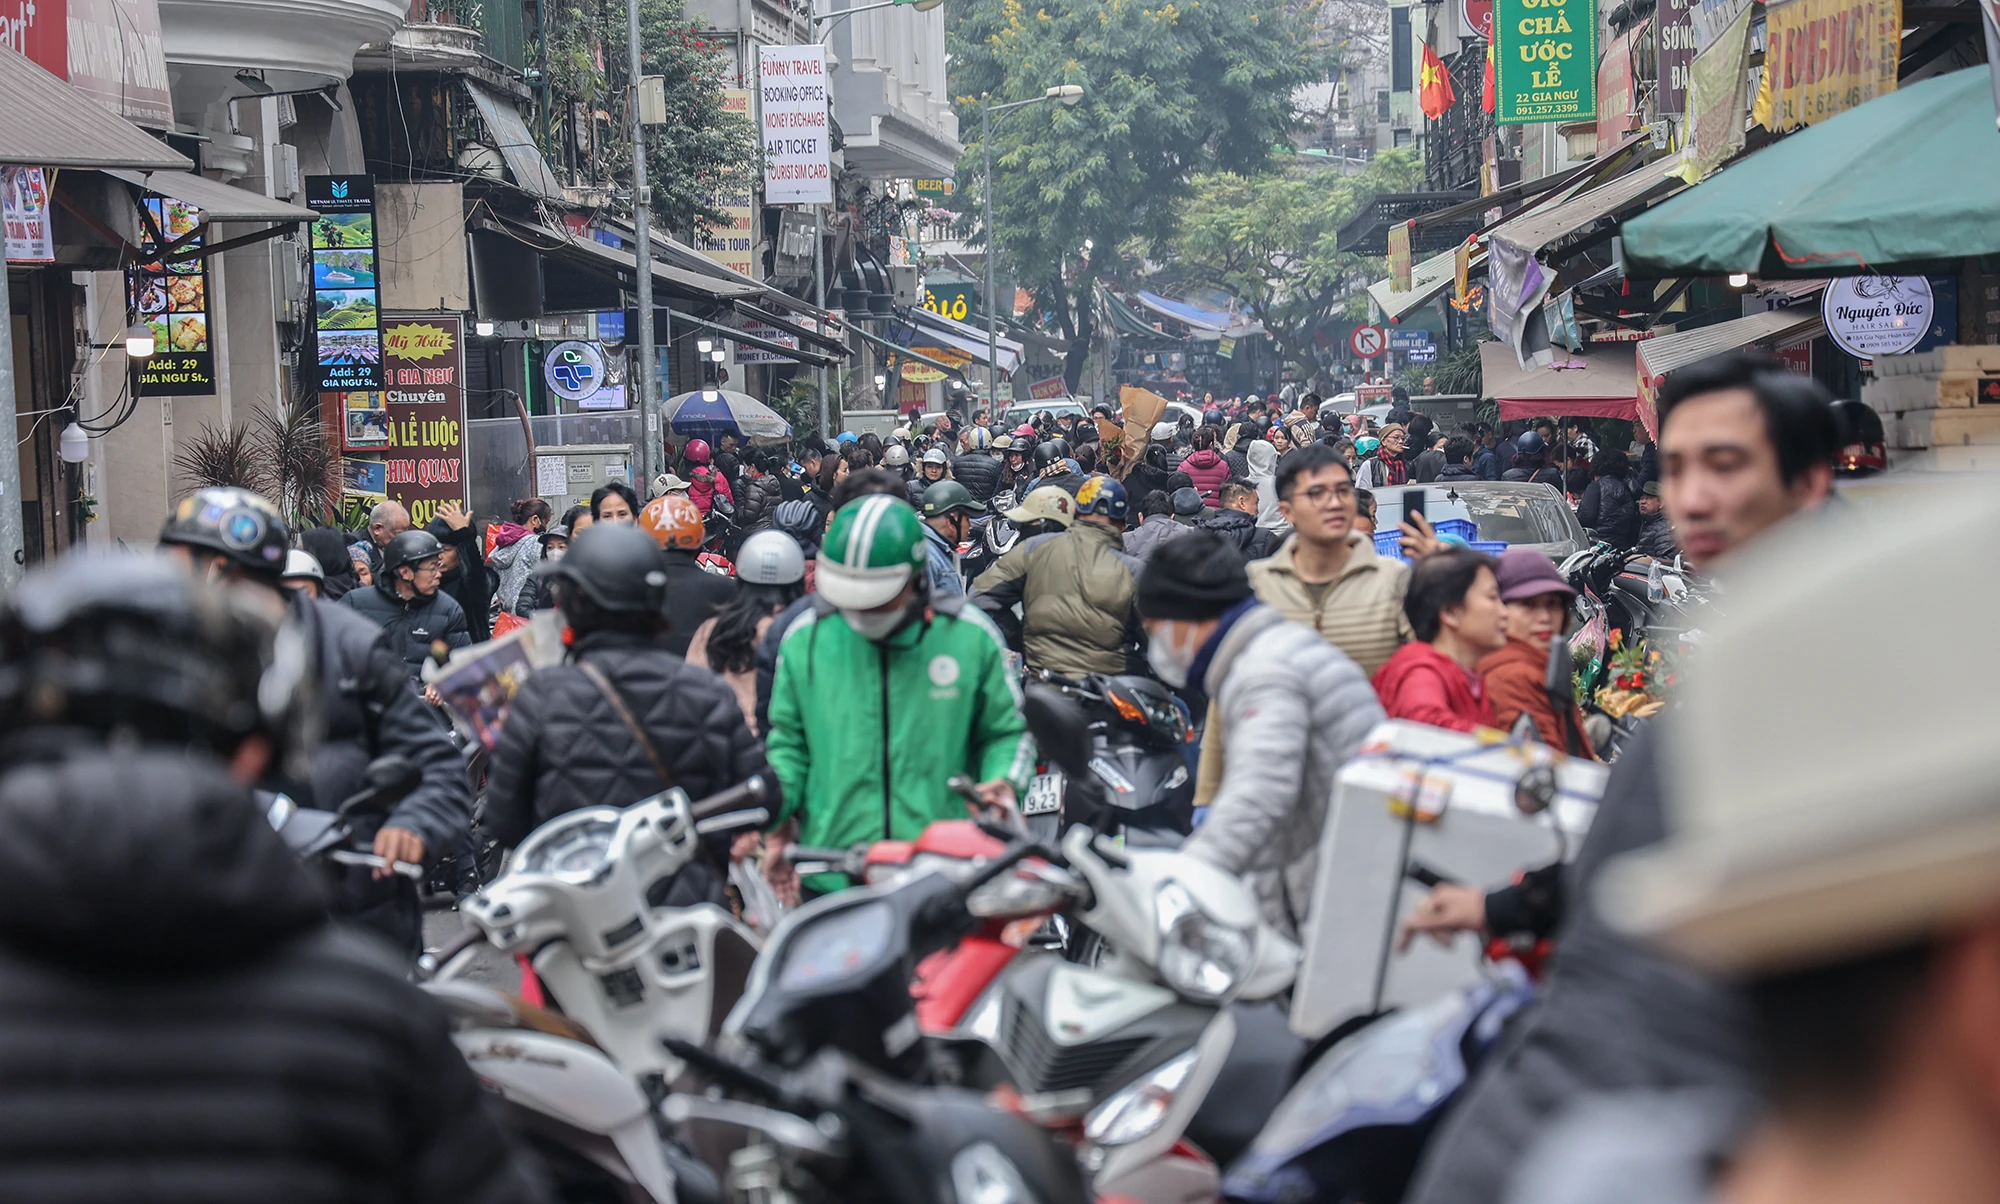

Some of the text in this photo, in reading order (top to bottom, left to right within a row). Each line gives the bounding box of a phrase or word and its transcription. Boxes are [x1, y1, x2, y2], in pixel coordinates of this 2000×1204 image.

[1518, 9, 1572, 36] CHẢ
[1519, 39, 1573, 62] ƯỚC
[762, 60, 822, 76] FUNNY TRAVEL
[1531, 61, 1563, 88] LỄ
[764, 86, 823, 102] BOOKING OFFICE
[1516, 89, 1579, 103] 22 GIA NGƯ
[1516, 104, 1578, 115] 091.257.3399
[765, 111, 825, 128] MONEY EXCHANGE
[767, 138, 817, 154] AIR TICKET
[794, 165, 807, 179] SIM
[808, 163, 827, 179] CARD
[917, 180, 942, 190] BEER
[735, 217, 750, 230] SIM
[728, 238, 750, 250] TOUR
[941, 294, 967, 320] LÔ
[1836, 301, 1923, 323] Nguyễn Đức
[388, 335, 408, 350] Mỹ
[764, 331, 777, 339] SIM
[737, 352, 760, 361] MONEY
[147, 359, 198, 371] Add: 29
[329, 367, 371, 377] Add: 29
[161, 373, 190, 383] NGƯ
[322, 379, 340, 387] GIA
[341, 378, 363, 387] NGƯ
[398, 368, 421, 386] GIA
[424, 366, 455, 386] NGƯ
[387, 389, 446, 404] Chuyên
[401, 411, 418, 447] LỄ
[422, 415, 459, 452] LUỘC
[386, 459, 460, 488] HIM QUAY
